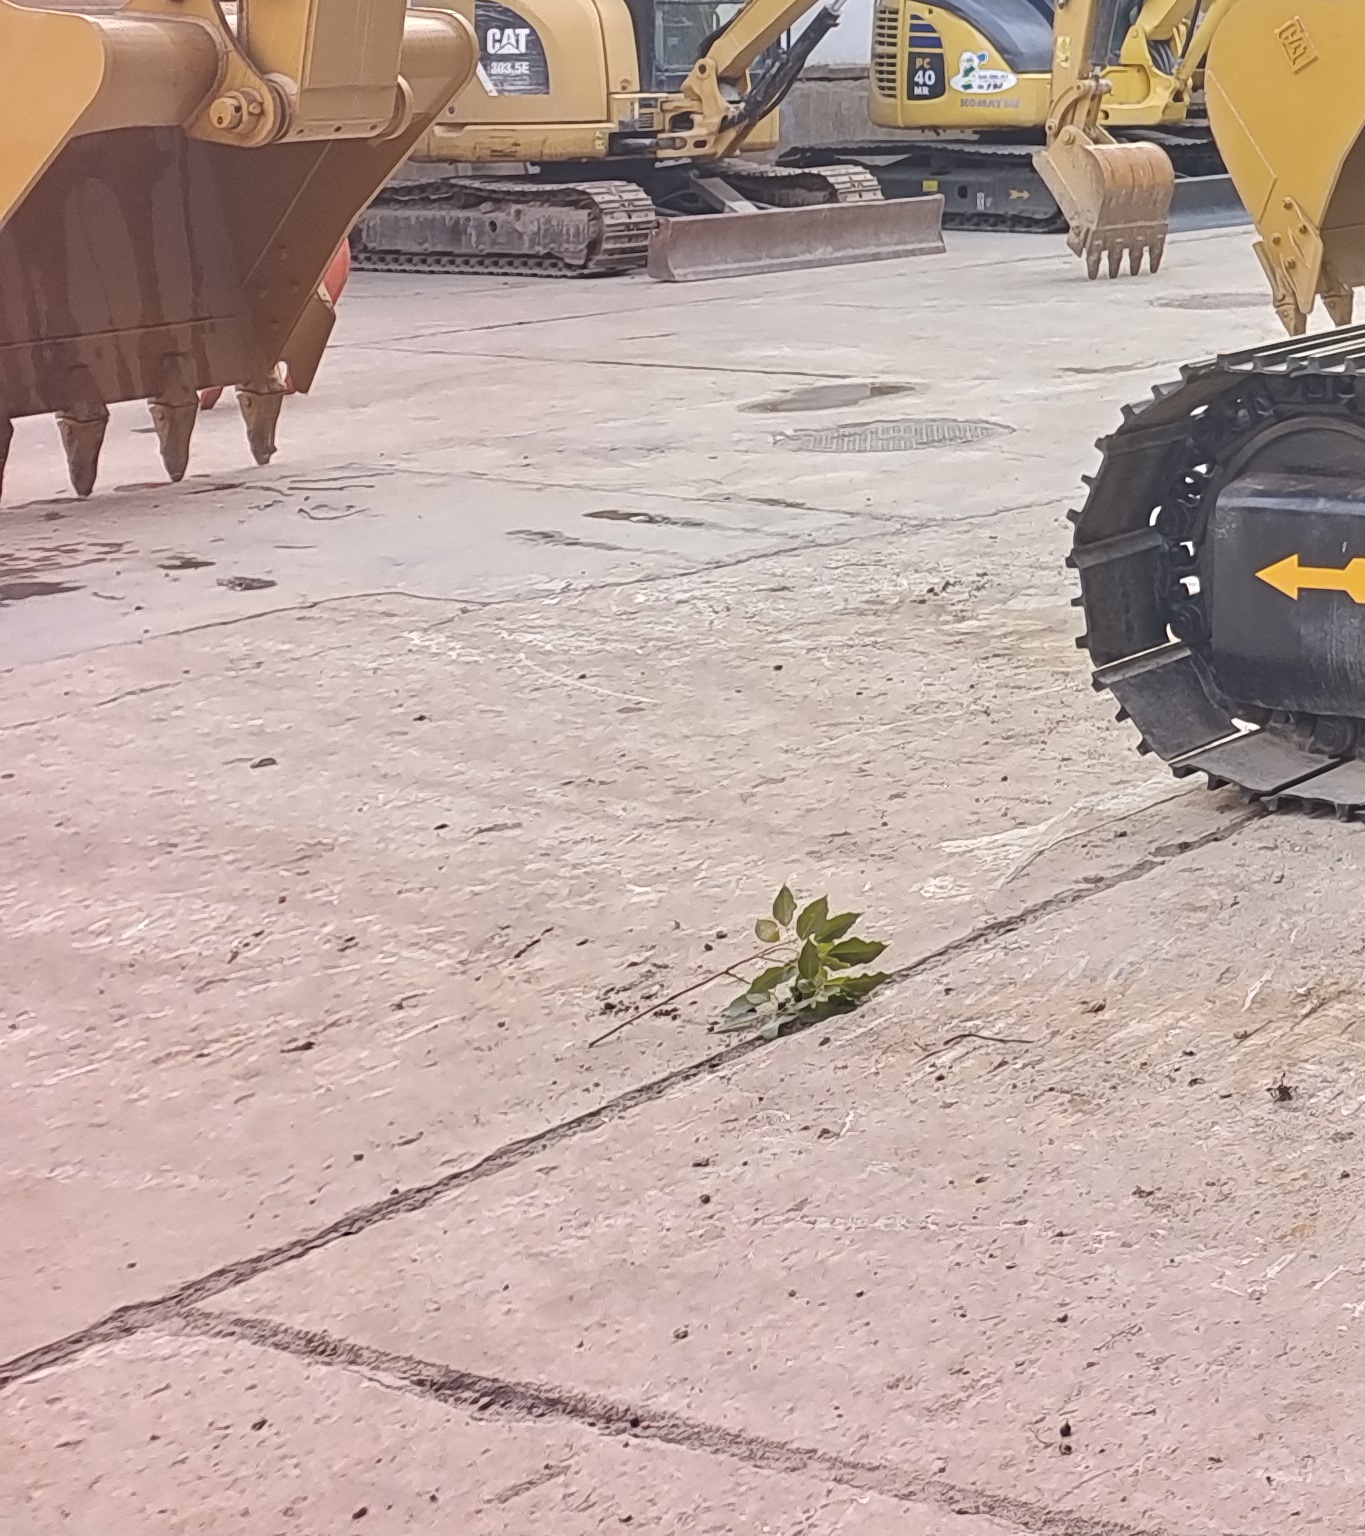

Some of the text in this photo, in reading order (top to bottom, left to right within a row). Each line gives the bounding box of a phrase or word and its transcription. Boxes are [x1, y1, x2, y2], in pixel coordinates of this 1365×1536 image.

[486, 27, 530, 54] CAT
[915, 57, 931, 69] PC
[913, 69, 936, 85] 40
[913, 85, 930, 95] MR
